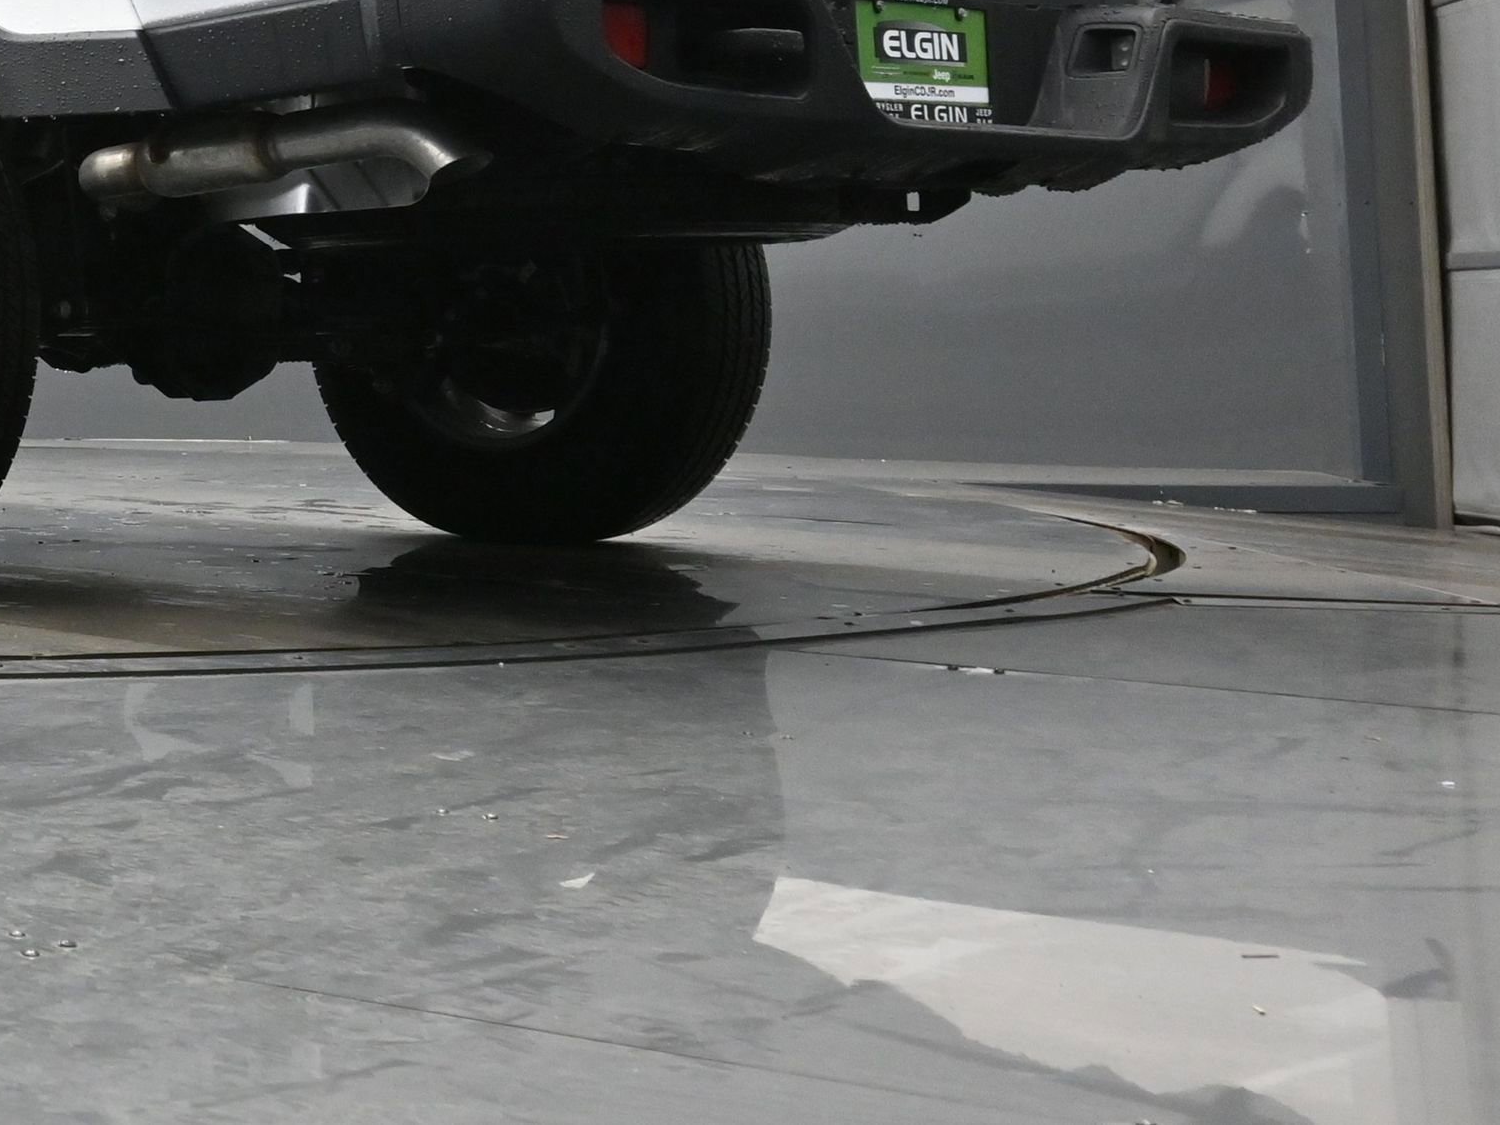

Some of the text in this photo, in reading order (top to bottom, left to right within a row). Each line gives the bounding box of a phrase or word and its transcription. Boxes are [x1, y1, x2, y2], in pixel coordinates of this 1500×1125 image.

[883, 30, 960, 62] ELGIN
[933, 69, 951, 82] Jeep
[894, 84, 955, 98] ElginCDJR.com
[910, 104, 968, 124] ELGIN
[975, 108, 993, 117] JEEP
